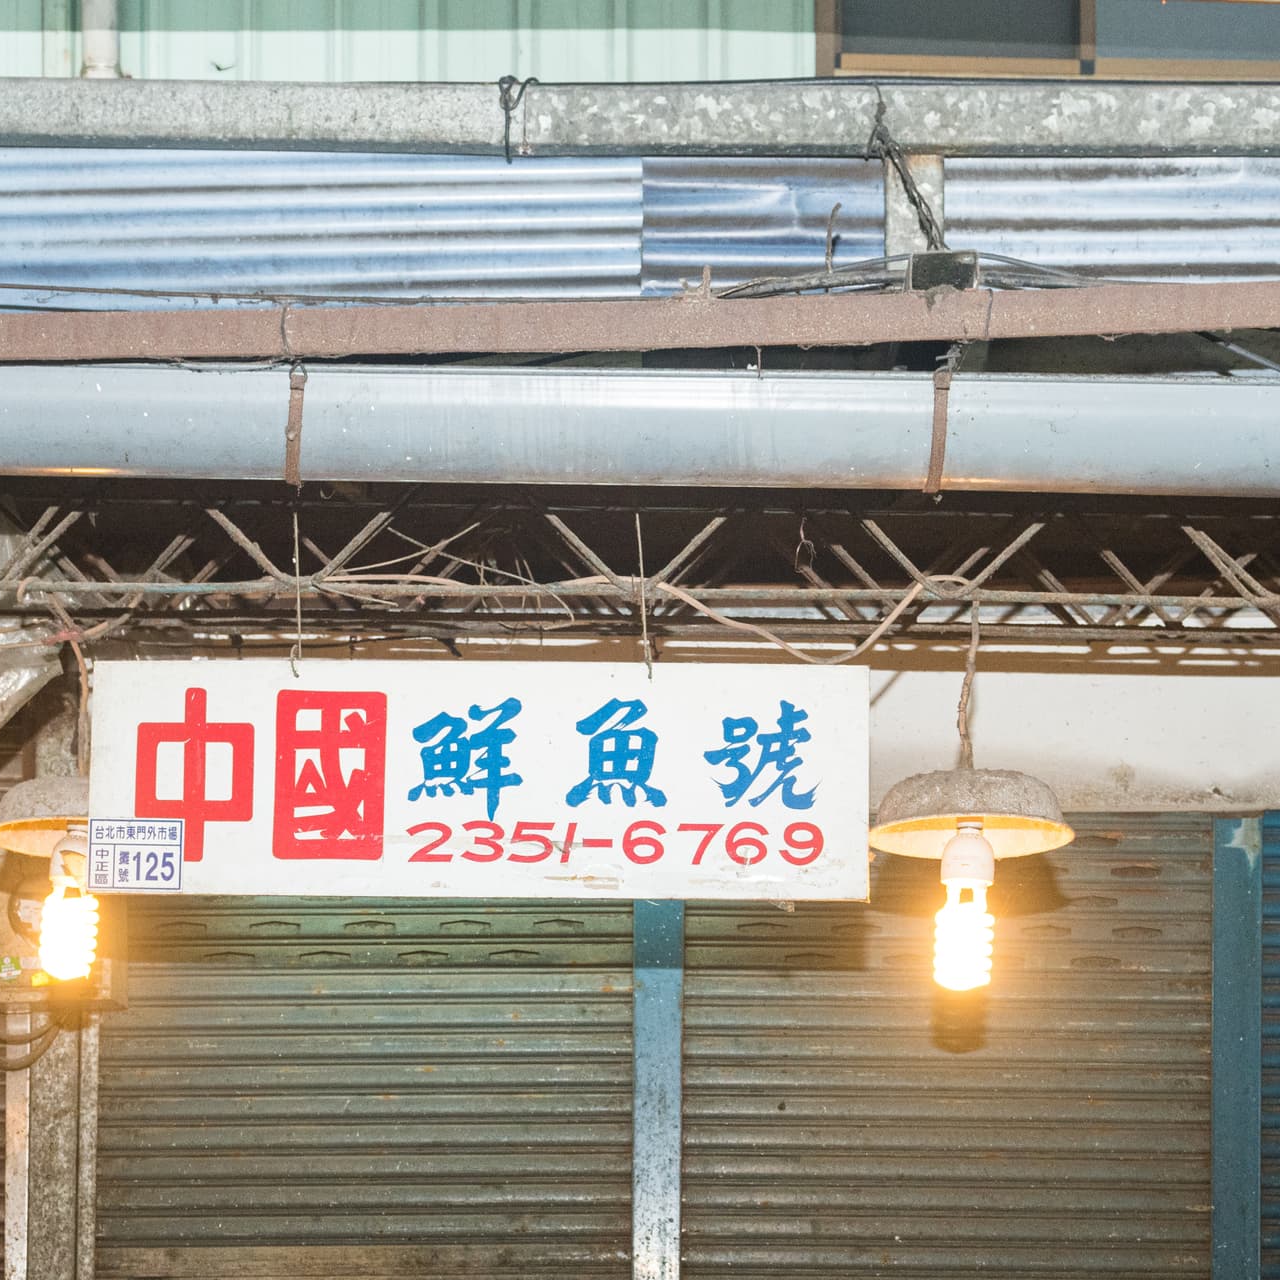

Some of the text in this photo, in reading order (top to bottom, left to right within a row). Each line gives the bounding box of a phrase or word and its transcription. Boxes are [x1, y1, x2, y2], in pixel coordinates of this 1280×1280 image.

[95, 825, 177, 840] 台北市東門外市場
[407, 821, 825, 866] 2351-6769
[95, 848, 109, 884] 中正區
[132, 851, 174, 881] 125
